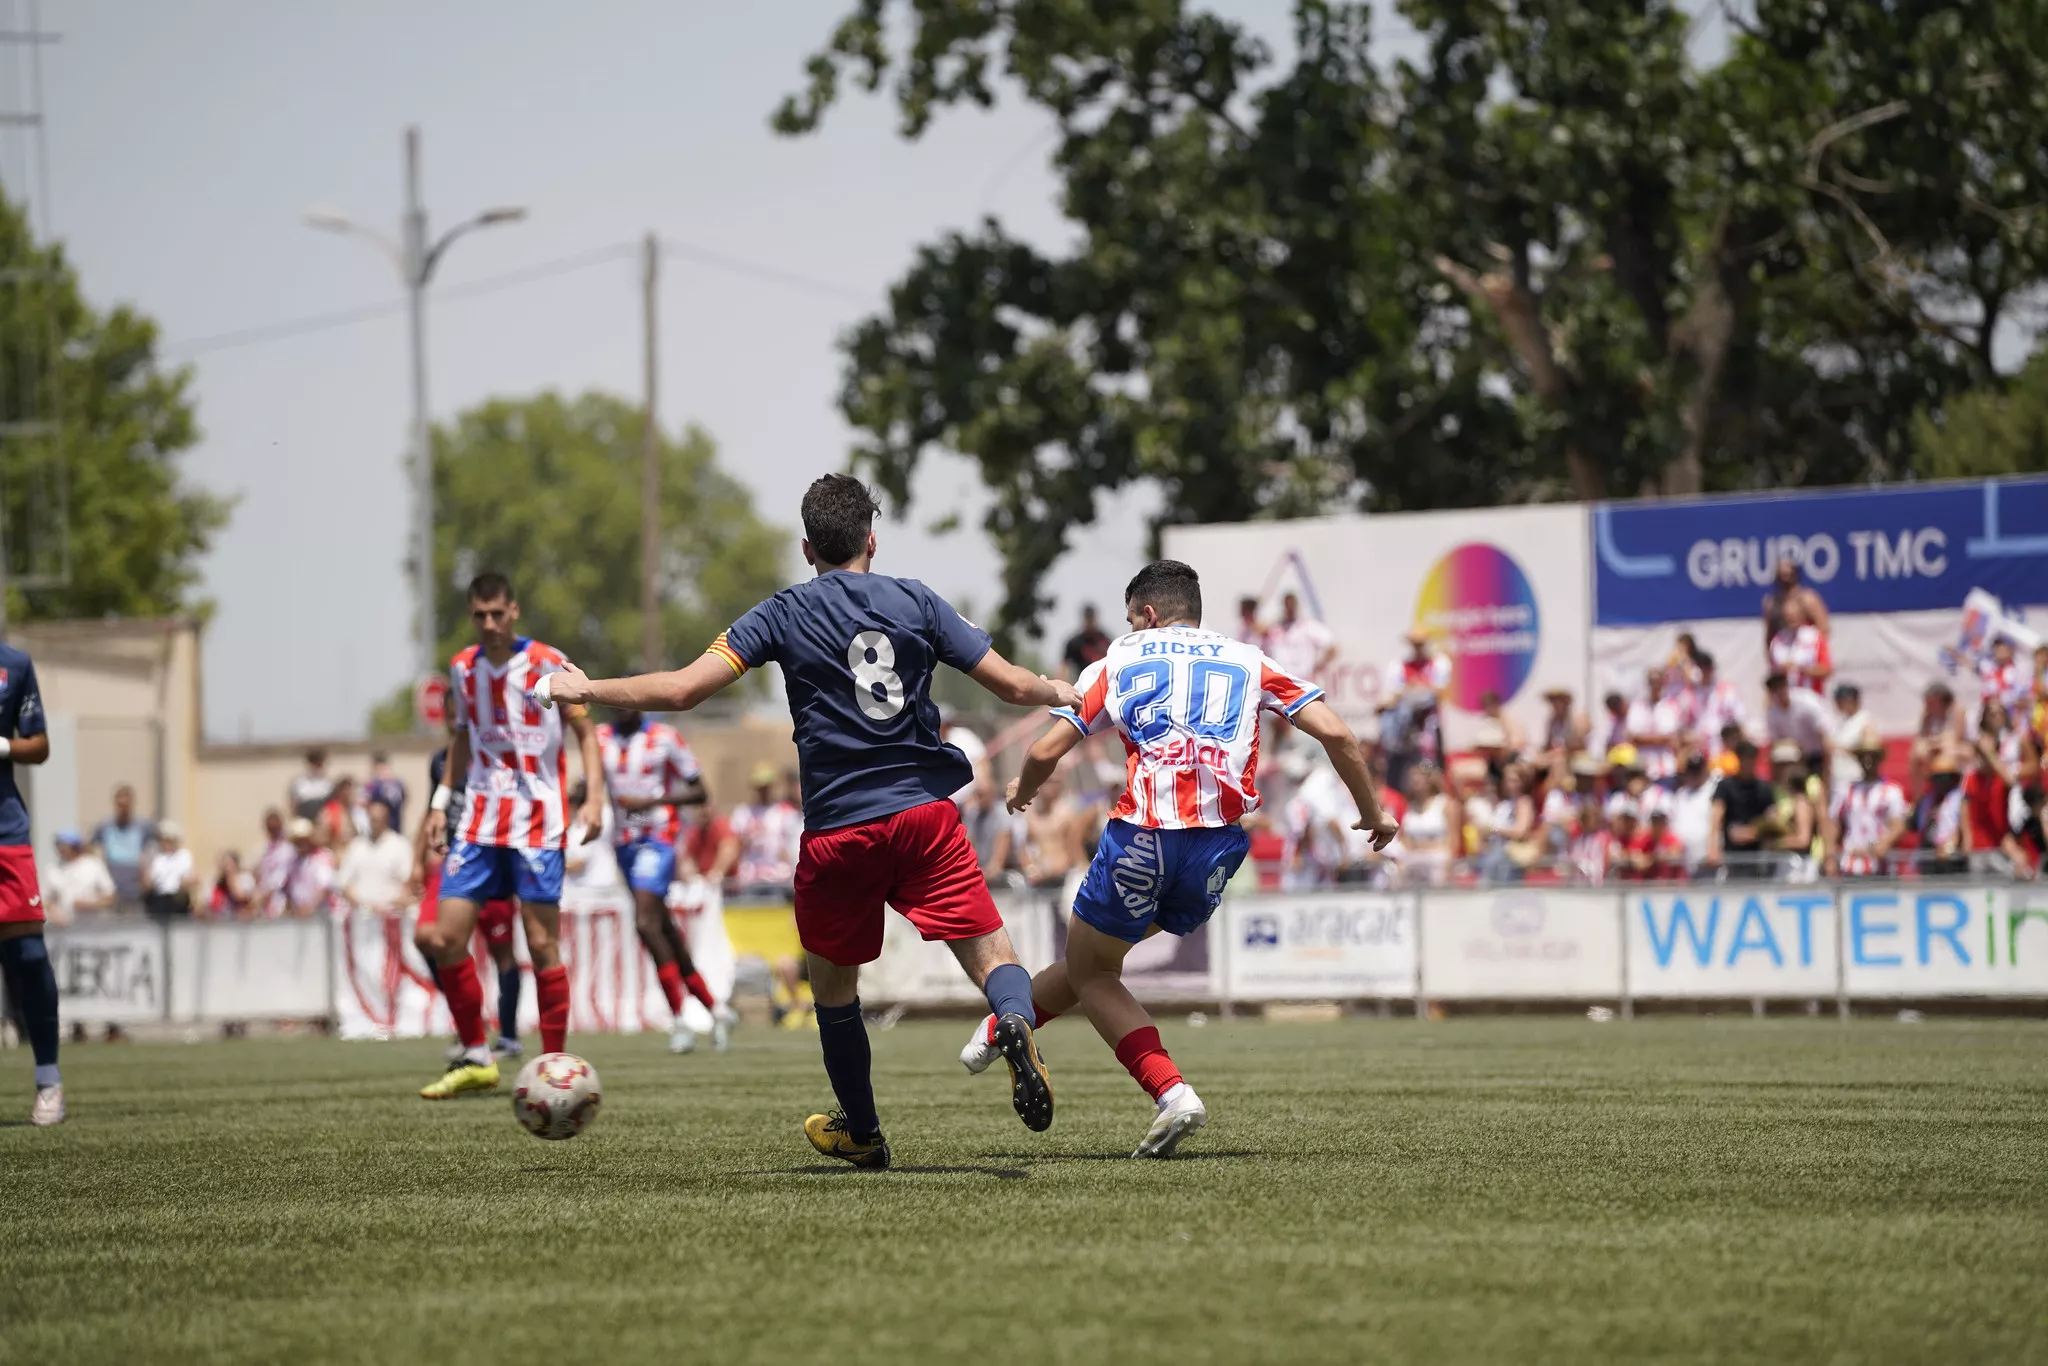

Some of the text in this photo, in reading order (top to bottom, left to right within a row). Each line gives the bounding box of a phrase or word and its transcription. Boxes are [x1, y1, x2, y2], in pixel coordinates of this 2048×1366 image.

[1687, 526, 1948, 590] GRUPO TMC
[847, 630, 905, 721] 8
[1140, 641, 1225, 657] RICKY
[1116, 657, 1251, 745] 20
